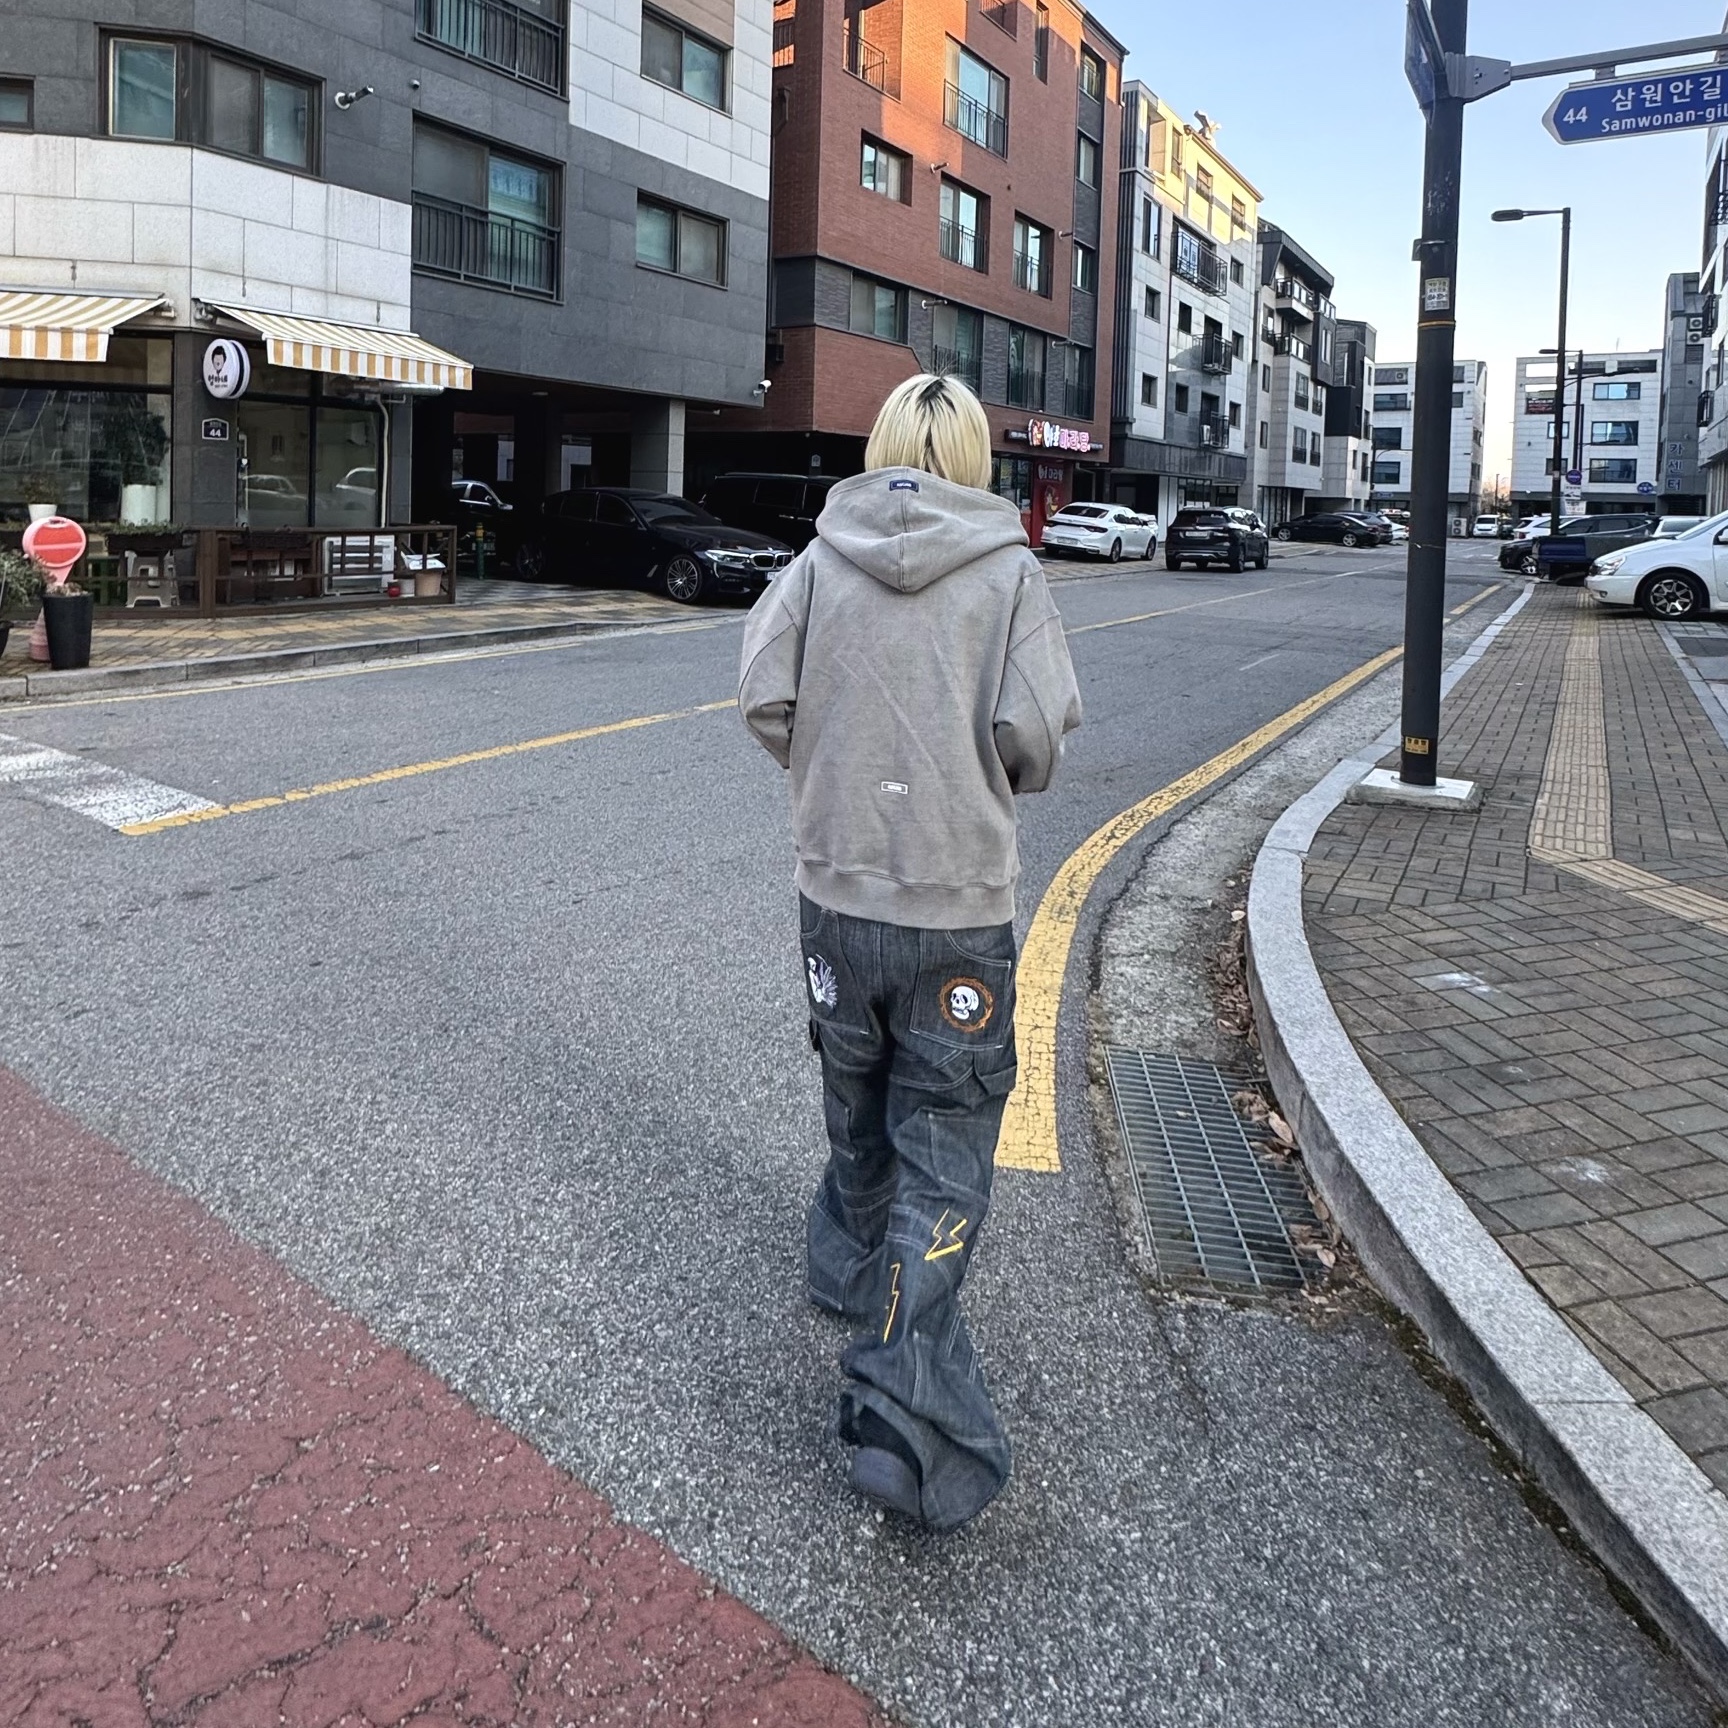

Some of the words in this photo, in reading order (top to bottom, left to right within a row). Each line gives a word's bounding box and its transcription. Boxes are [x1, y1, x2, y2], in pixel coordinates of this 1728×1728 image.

[1611, 74, 1722, 112] 삼원안길
[1562, 106, 1589, 124] 44
[1601, 104, 1728, 133] Samwonan-gil
[209, 428, 222, 437] 44
[1666, 442, 1684, 491] 카센터
